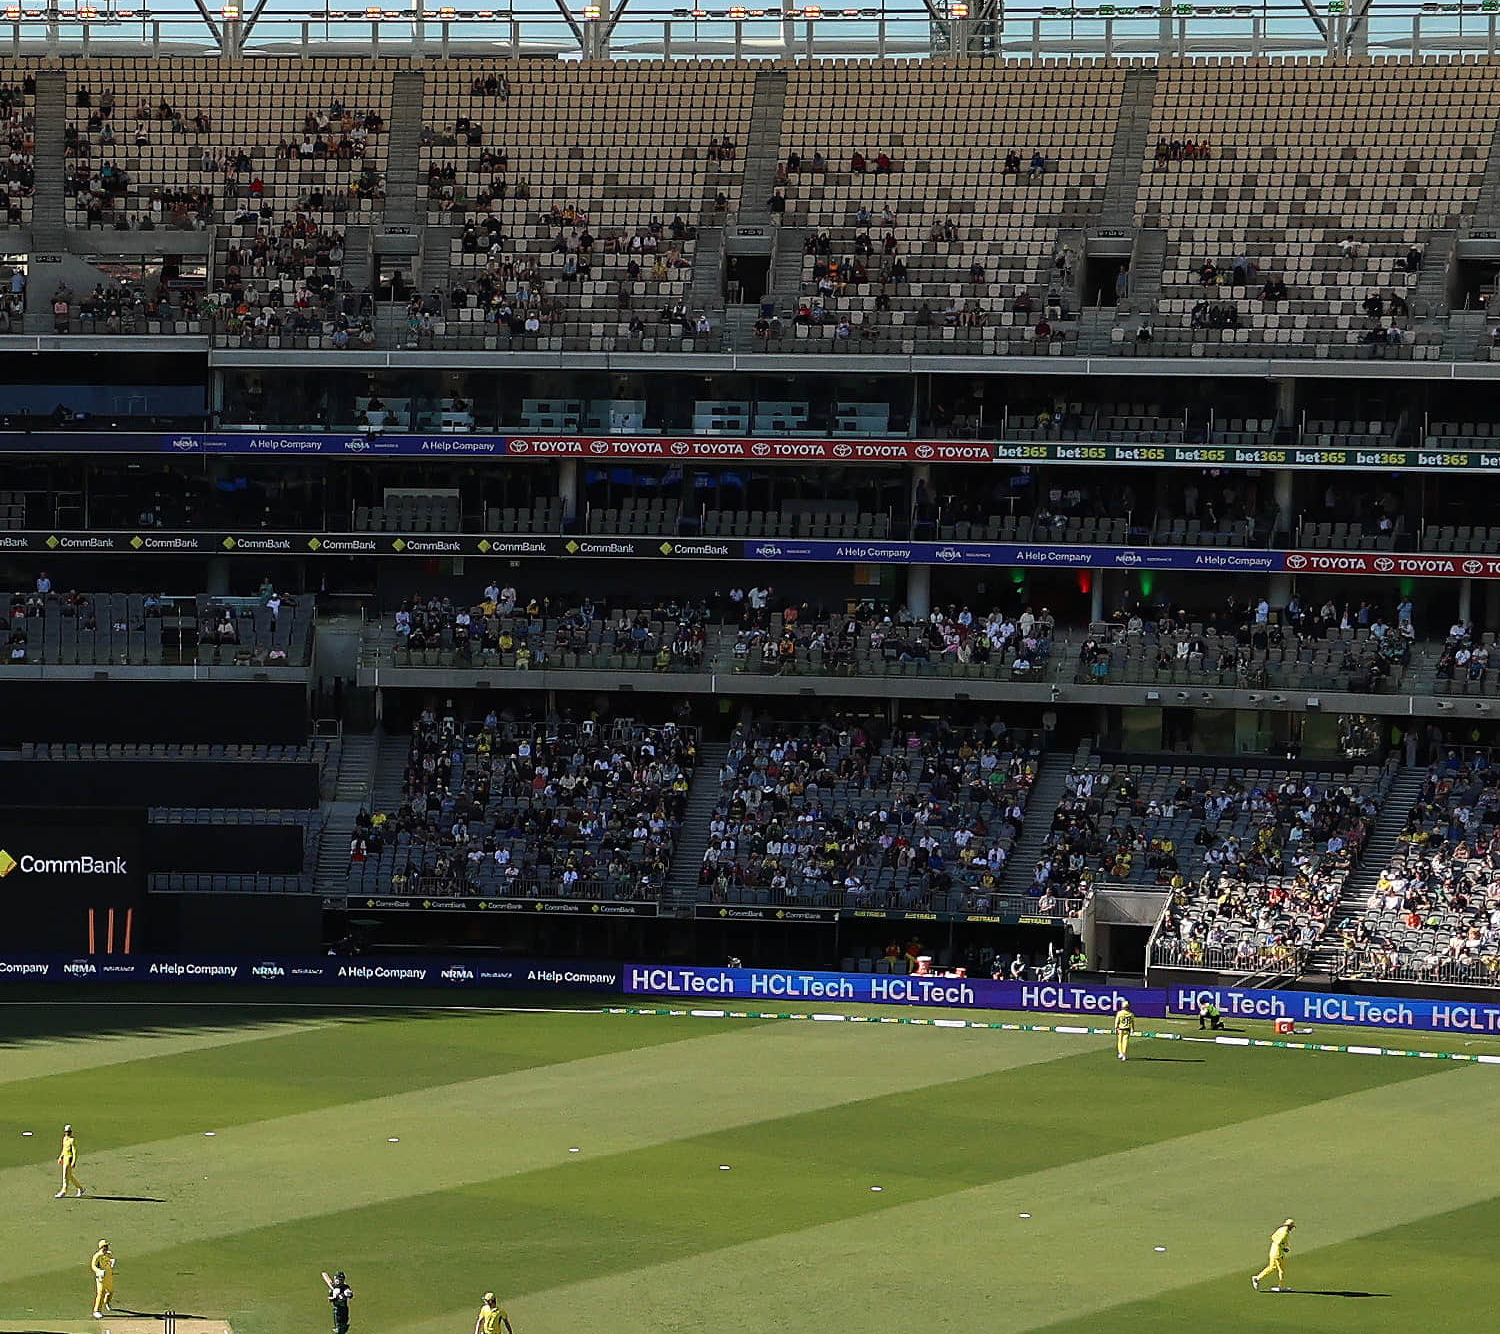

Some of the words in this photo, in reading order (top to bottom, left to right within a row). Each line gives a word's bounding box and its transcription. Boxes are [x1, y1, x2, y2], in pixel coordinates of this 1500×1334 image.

[430, 441, 451, 451] Help
[452, 441, 494, 451] Company
[532, 442, 582, 451] TOYOTA
[612, 443, 662, 452] TOYOTA
[774, 445, 825, 454] TOYOTA
[856, 446, 907, 456] TOYOTA
[938, 447, 989, 457] TOYOTA
[999, 446, 1048, 458] bet365
[1116, 448, 1165, 460] bet365
[1176, 449, 1225, 461] bet365
[1296, 451, 1346, 463] bet365
[1418, 454, 1468, 466] bet365
[62, 537, 113, 548] CommBank
[237, 538, 290, 549] CommBank
[407, 540, 460, 551] CommBank
[493, 541, 546, 552] CommBank
[675, 544, 728, 555] CommBank
[845, 547, 866, 558] Help
[867, 548, 910, 559] Company
[1311, 557, 1366, 569] TOYOTA
[20, 855, 128, 874] CommBank
[64, 964, 96, 973] NRMA
[150, 963, 159, 973] A
[160, 963, 185, 974] Help
[186, 963, 237, 976] Company
[252, 966, 284, 975] NRMA
[338, 966, 347, 976] A
[348, 966, 373, 978] Help
[374, 967, 426, 979] Company
[441, 969, 473, 979] NRMA
[528, 970, 536, 979] A
[537, 970, 563, 982] Help
[564, 971, 615, 984] Company
[632, 969, 733, 993] HCLTech
[752, 974, 853, 998] HCLTech
[871, 979, 973, 1003] HCLTech
[1022, 987, 1127, 1011] HCLTech
[1304, 999, 1412, 1024] HCLTech
